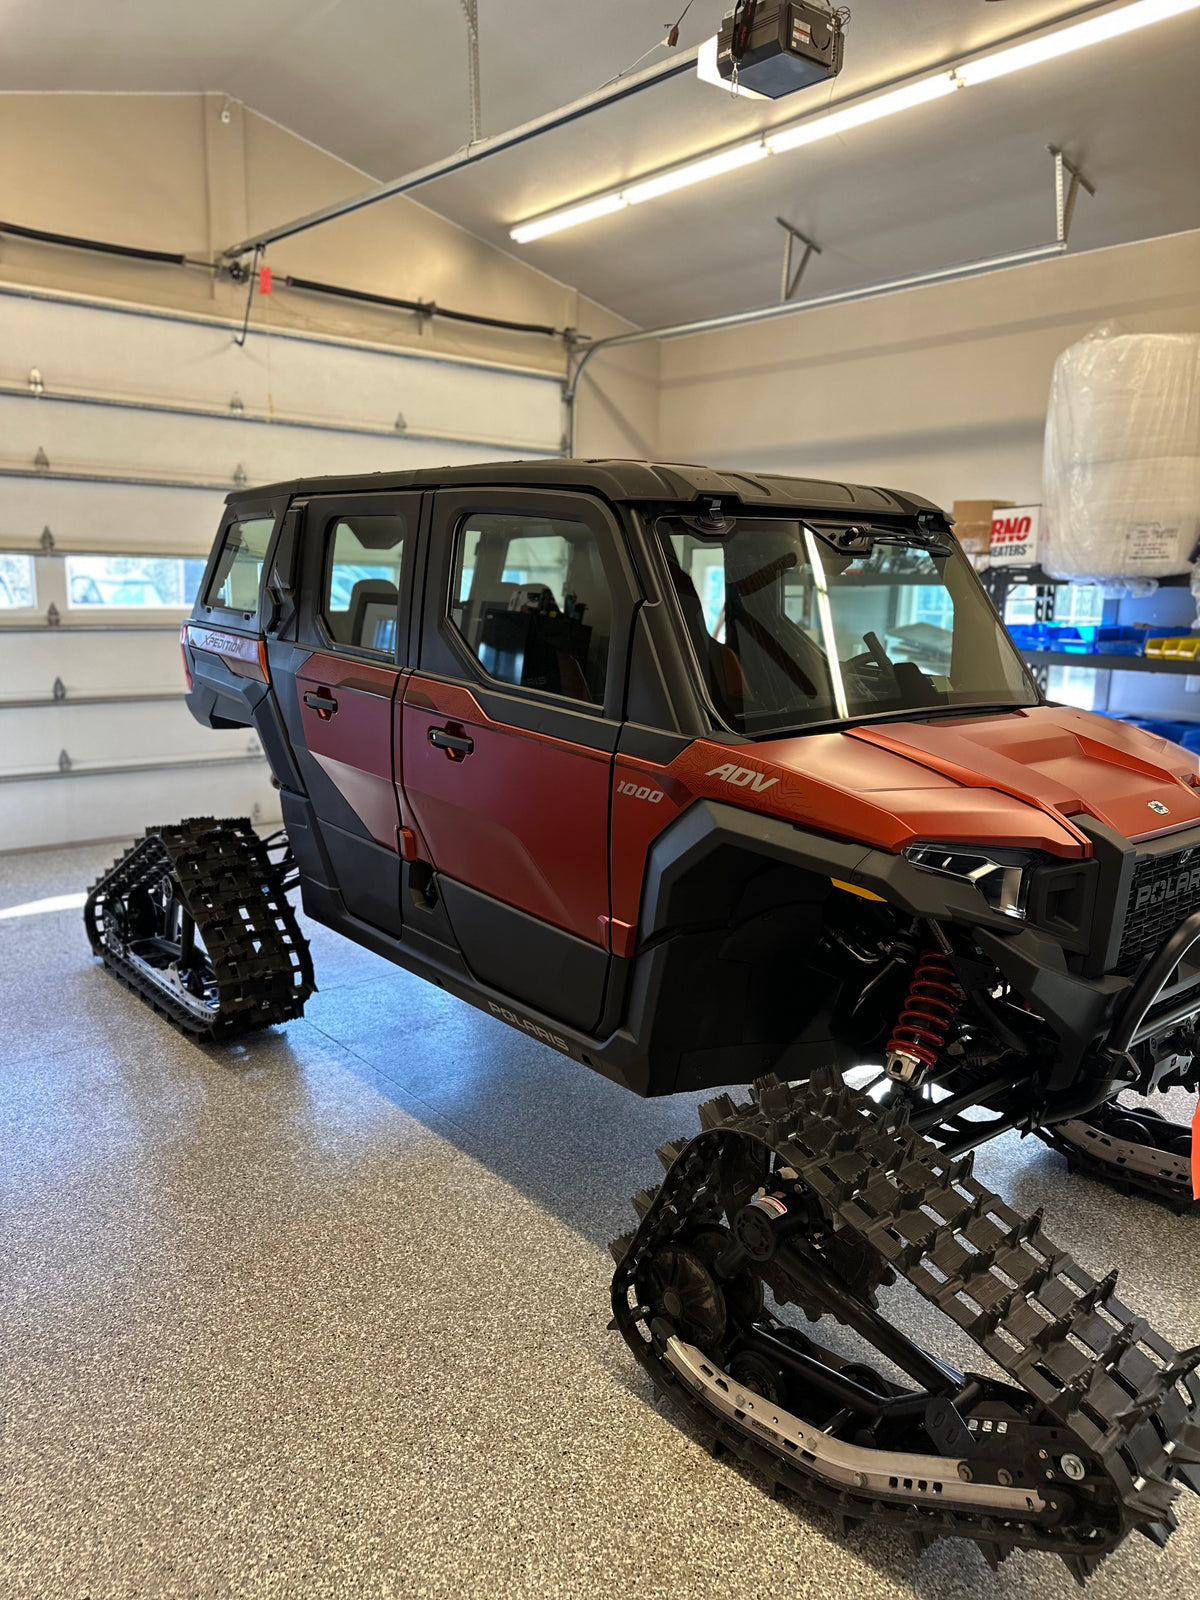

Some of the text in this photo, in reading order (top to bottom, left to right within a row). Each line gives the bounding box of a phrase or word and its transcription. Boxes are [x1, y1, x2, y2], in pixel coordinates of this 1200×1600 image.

[200, 632, 243, 654] XPEDITION
[705, 763, 780, 793] ADV
[616, 780, 665, 804] 1000
[487, 1001, 570, 1052] POLARIS
